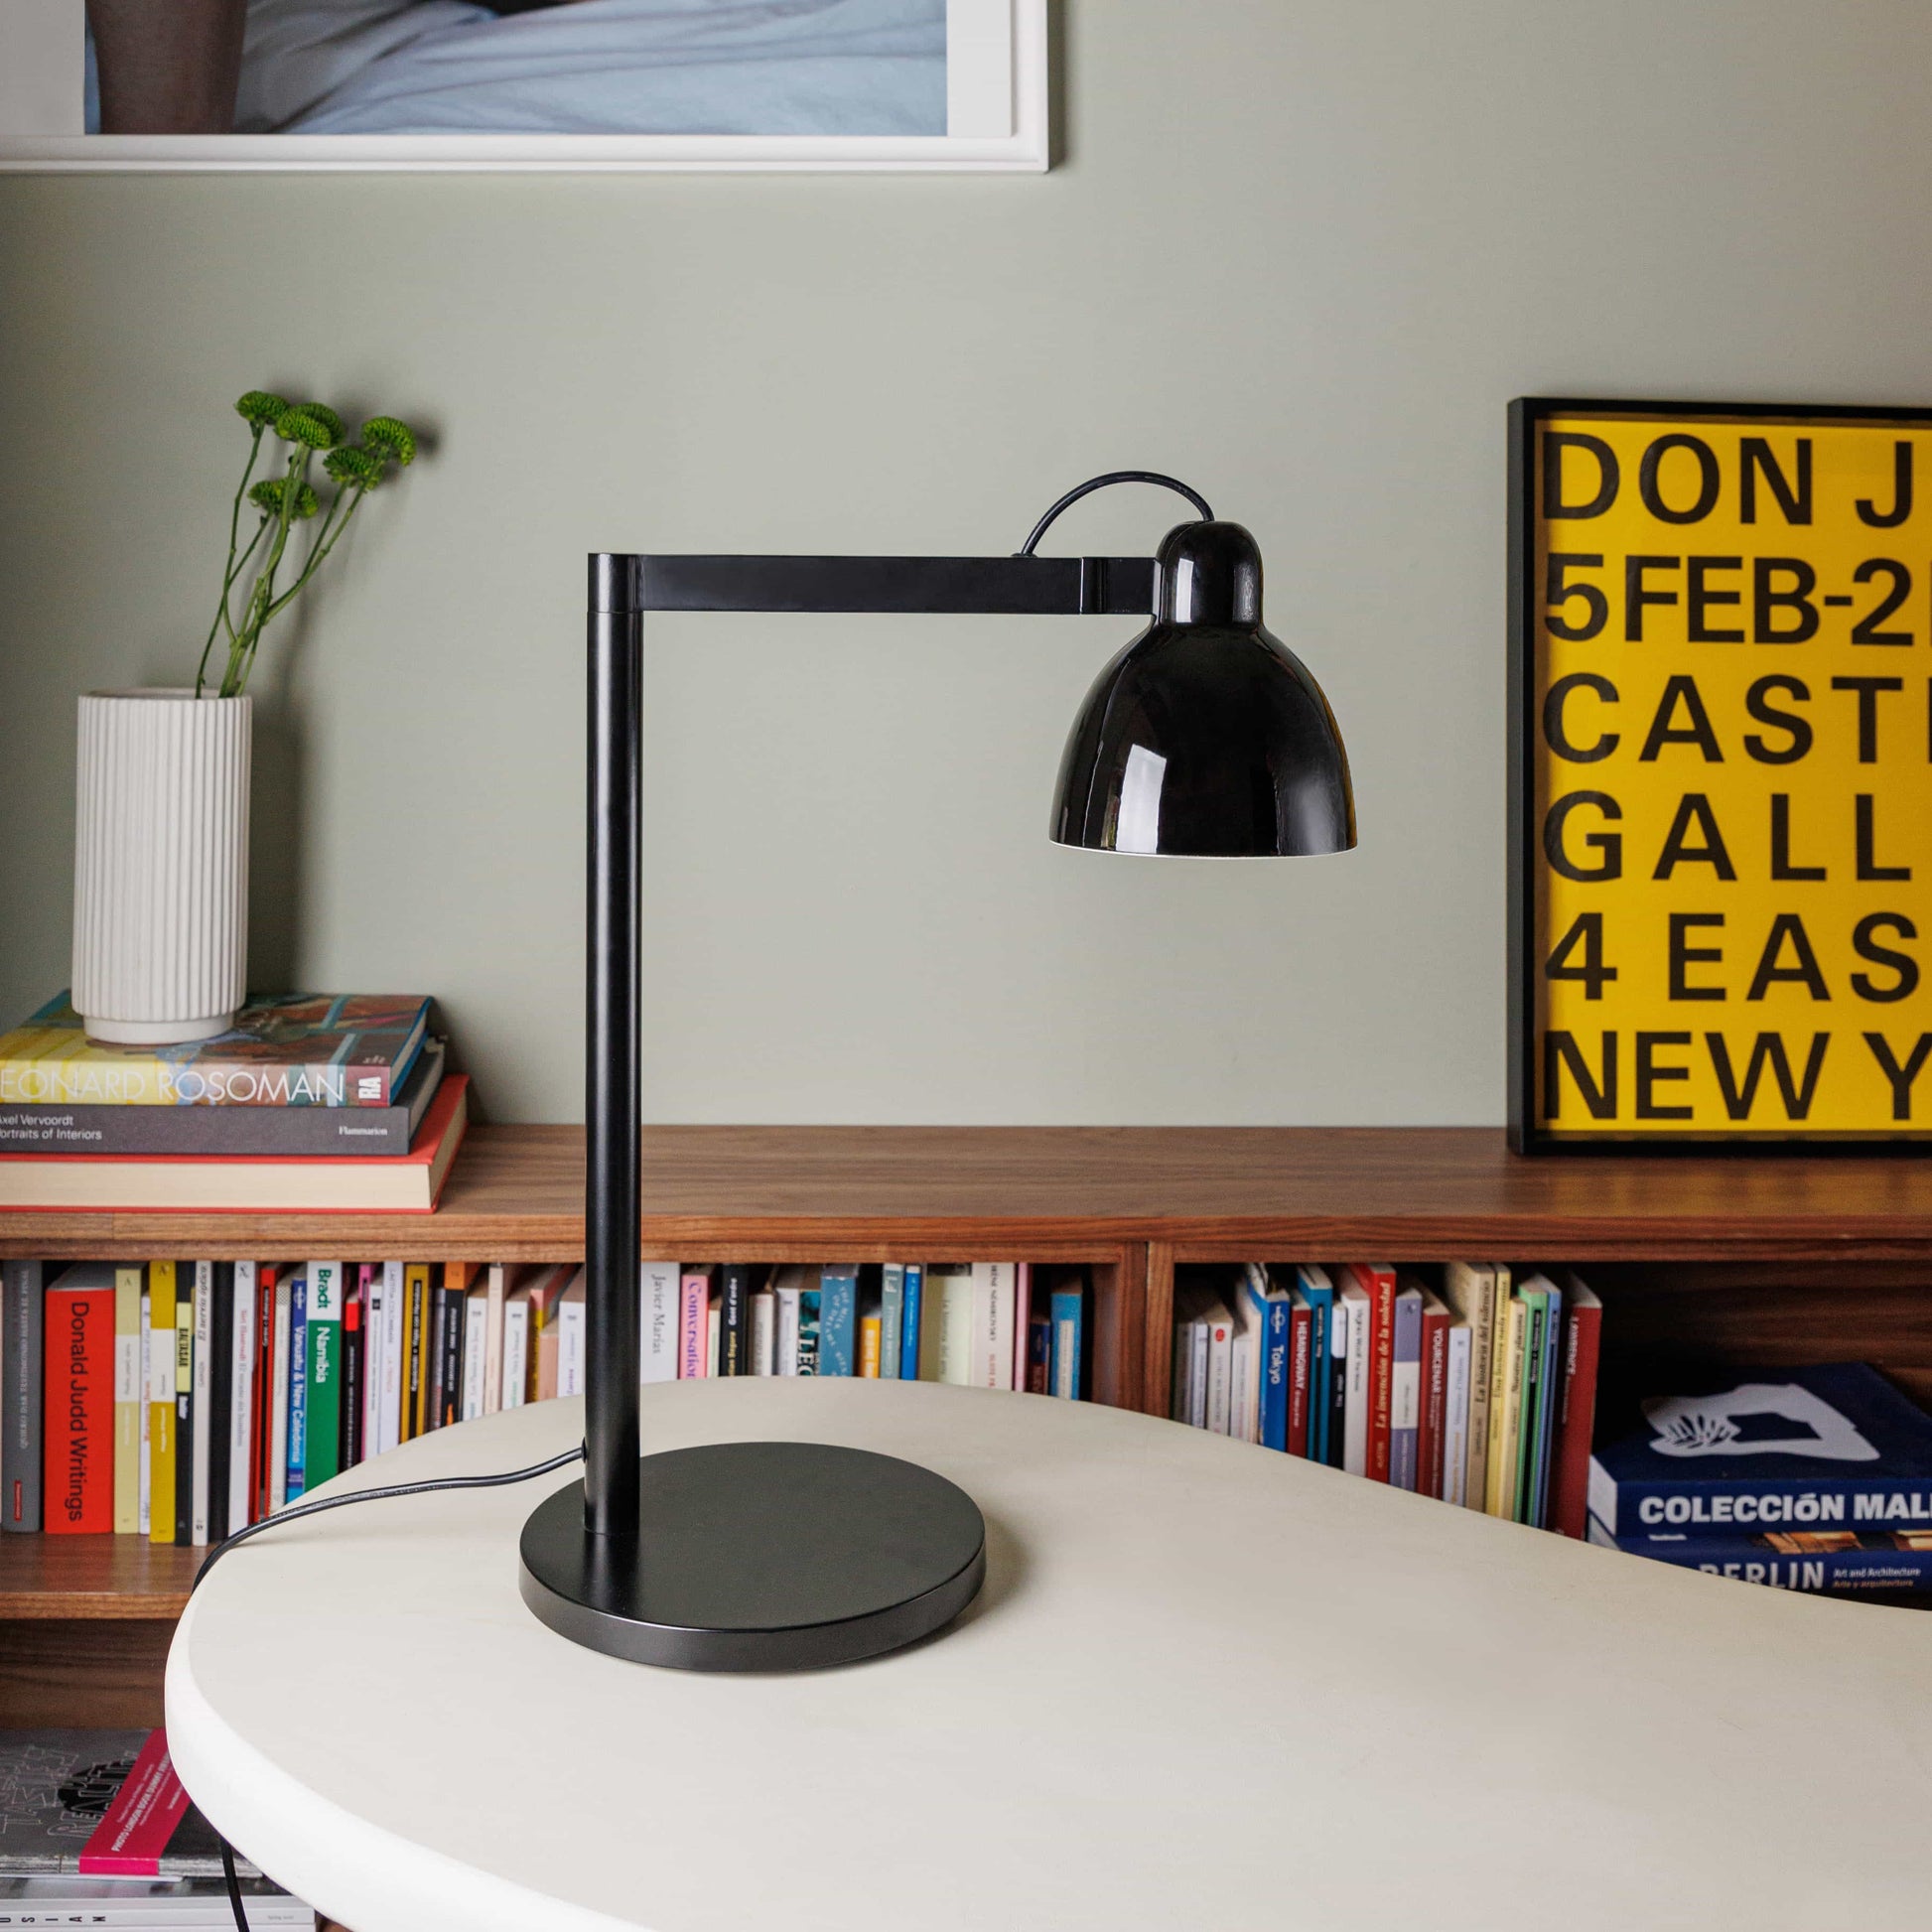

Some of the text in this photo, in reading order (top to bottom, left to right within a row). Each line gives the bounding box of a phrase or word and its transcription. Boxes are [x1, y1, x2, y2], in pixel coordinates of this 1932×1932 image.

[1543, 432, 1913, 528] DON J
[1544, 552, 1932, 646] 5FEB-2
[1543, 672, 1932, 764] CAST
[1543, 790, 1911, 882] GALL
[1545, 911, 1921, 1003] 4 EAS
[158, 1071, 345, 1103] ROSOMAN
[1544, 1031, 1932, 1121] NEW Y
[0, 1128, 102, 1141] ortraits of Interiors
[20, 1114, 73, 1126] Vervoordt
[339, 1125, 388, 1137] Flammarion
[318, 1269, 332, 1310] Bradt
[650, 1275, 667, 1310] Javier
[1379, 1282, 1391, 1327] soledad
[1481, 1281, 1492, 1322] silencio
[294, 1325, 305, 1371] Vanuatu
[1379, 1328, 1390, 1339] la
[1379, 1340, 1389, 1356] de
[1480, 1325, 1491, 1342] del
[1567, 1315, 1579, 1376] LAWRENCE
[315, 1326, 332, 1384] Namibia
[1269, 1344, 1286, 1385] Tokyo
[1295, 1320, 1308, 1390] HEMINGWAY
[1432, 1327, 1444, 1395] YOURCENAR
[1478, 1344, 1489, 1385] historia
[293, 1384, 304, 1409] New
[294, 1372, 304, 1382] &
[1377, 1357, 1389, 1413] invención
[1475, 1387, 1486, 1404] La
[65, 1302, 89, 1522] Donald Judd Writings
[1376, 1415, 1387, 1429] La
[292, 1410, 304, 1463] Caledonia
[1854, 1493, 1932, 1520] MAL
[1834, 1569, 1848, 1579] Art
[1849, 1569, 1866, 1579] and
[1867, 1567, 1922, 1578] Architecture
